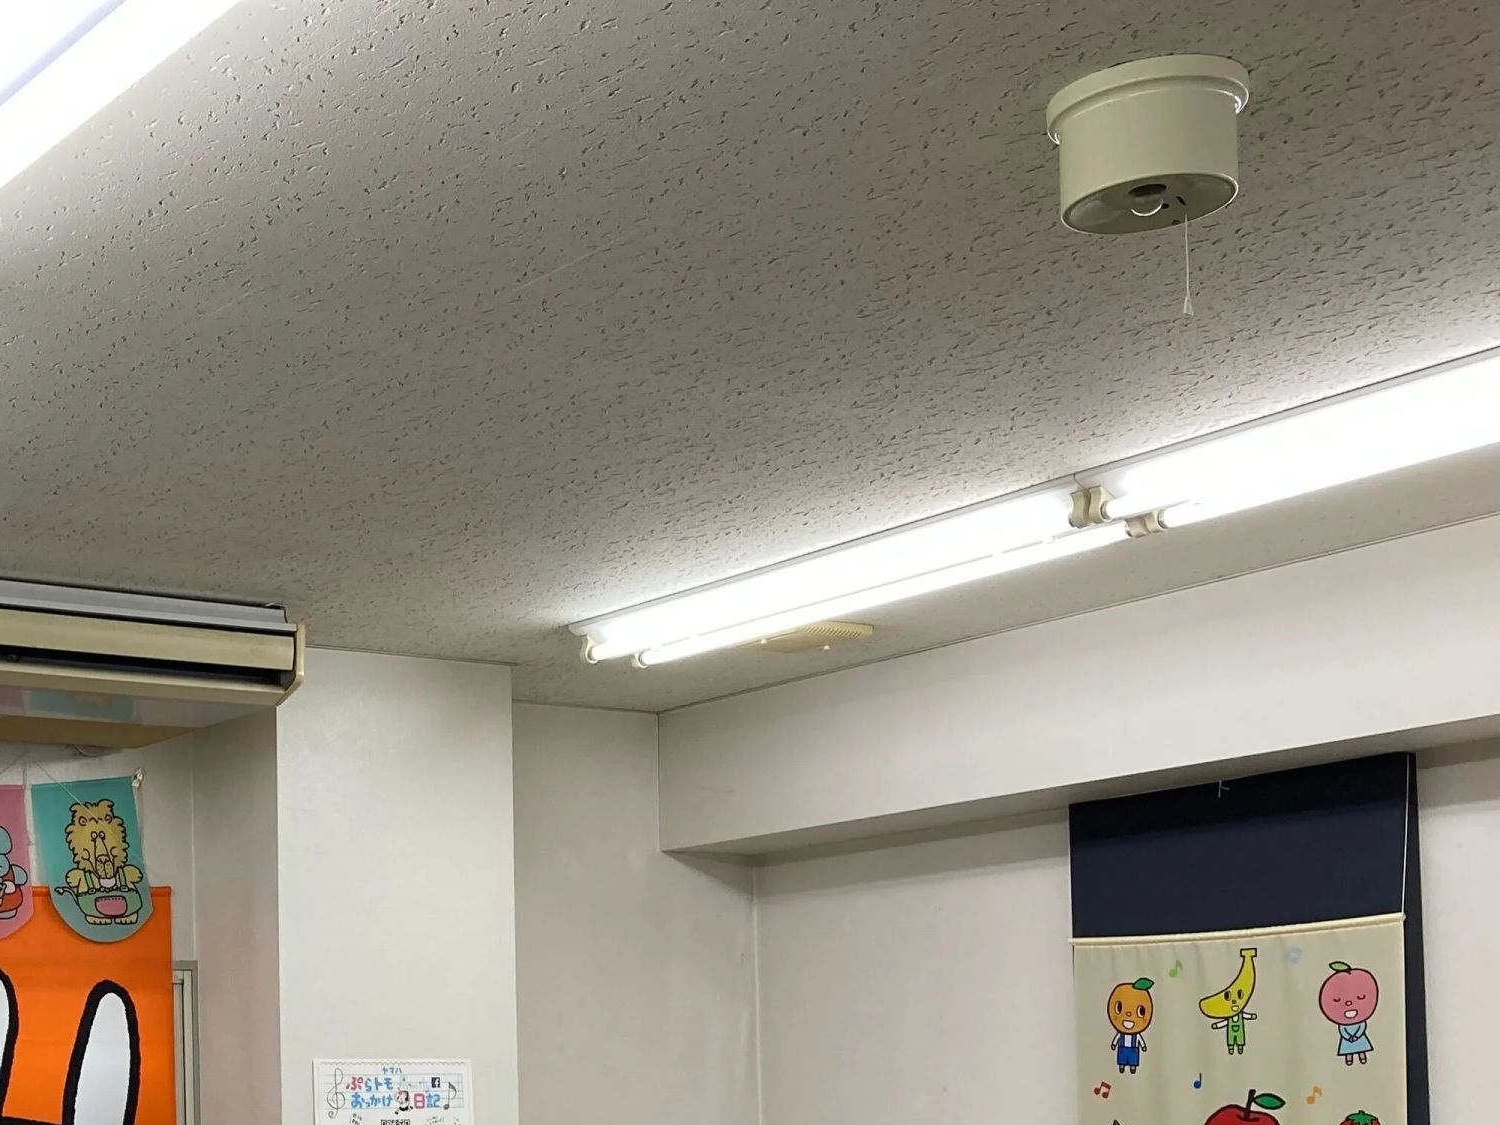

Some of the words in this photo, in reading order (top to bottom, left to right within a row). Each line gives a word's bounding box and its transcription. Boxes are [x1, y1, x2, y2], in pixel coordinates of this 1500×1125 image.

[346, 1076, 394, 1091] ぷらトモ
[350, 1092, 393, 1108] おっかけ
[414, 1092, 440, 1109] 日記
